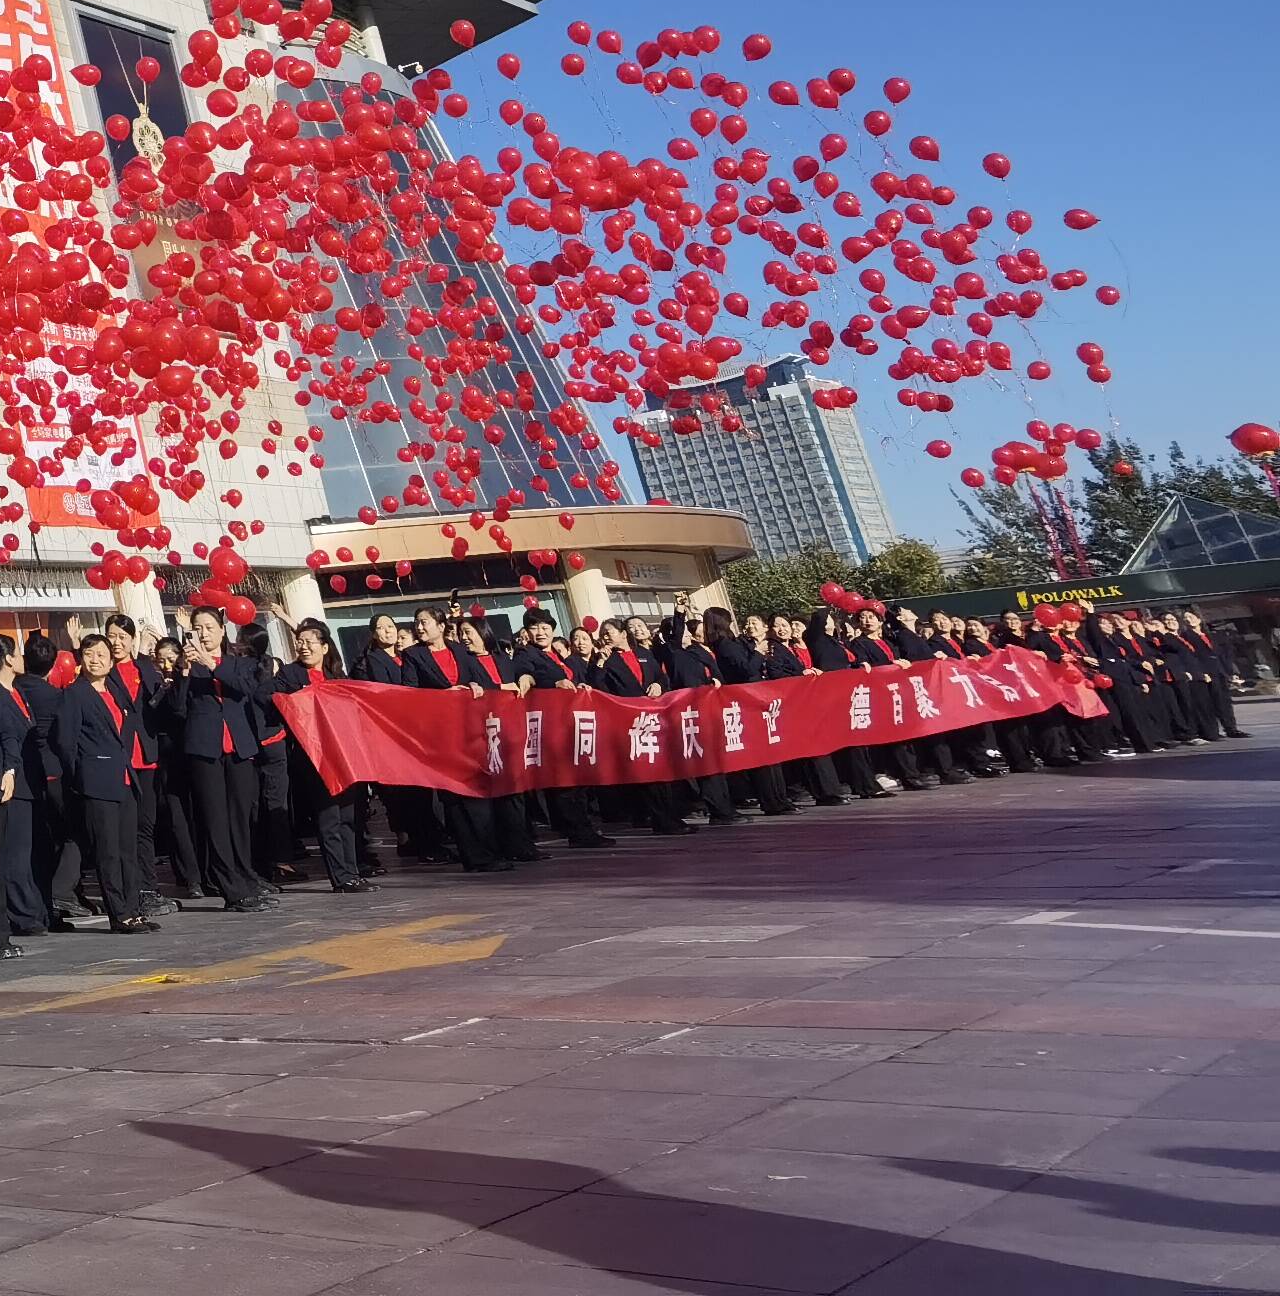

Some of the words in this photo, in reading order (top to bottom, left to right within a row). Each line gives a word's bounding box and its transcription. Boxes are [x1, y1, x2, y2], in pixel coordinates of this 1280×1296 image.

[1031, 585, 1124, 604] POLOWALK
[485, 698, 783, 775] 家国同辉庆盛世
